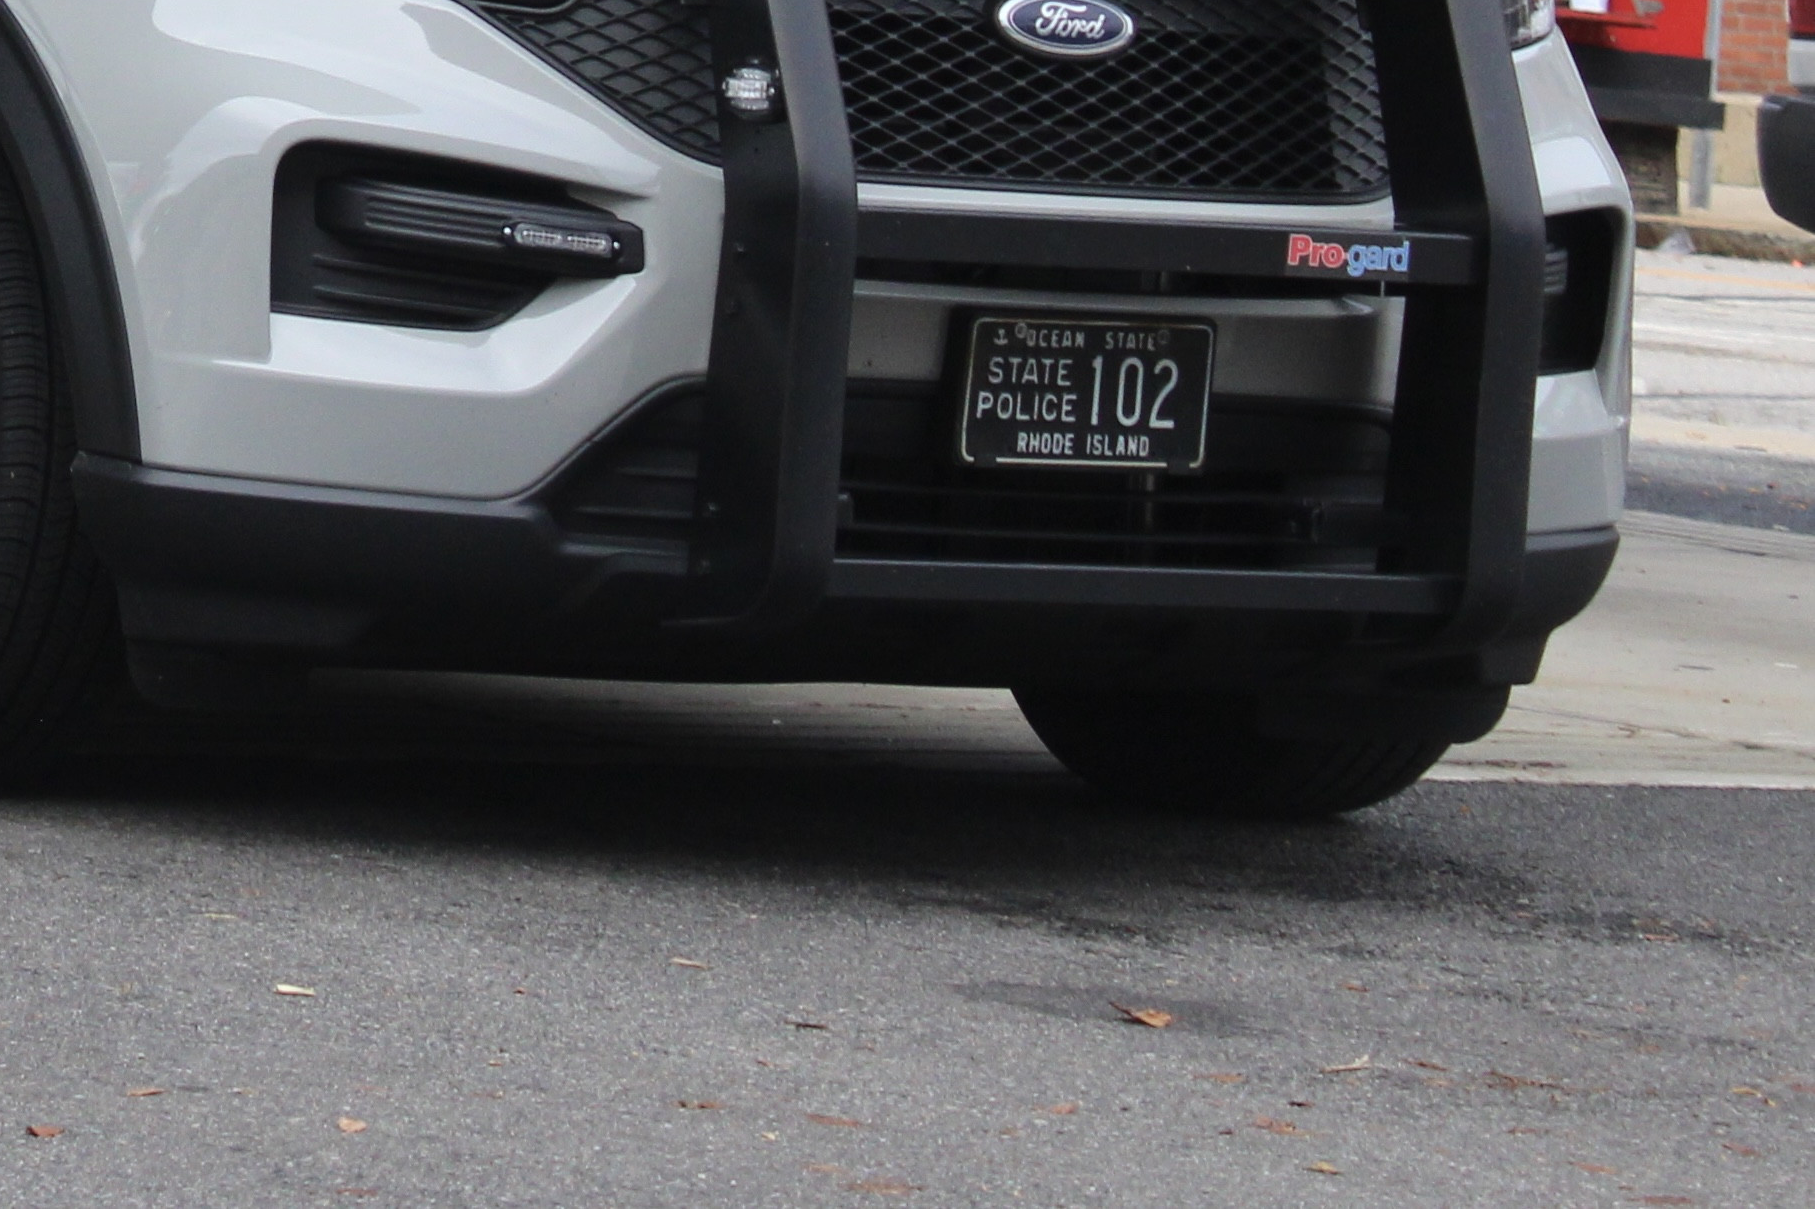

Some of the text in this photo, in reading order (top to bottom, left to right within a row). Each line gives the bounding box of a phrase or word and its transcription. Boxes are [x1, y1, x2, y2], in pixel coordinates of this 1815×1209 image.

[1035, 1, 1105, 39] Ford
[1026, 329, 1157, 351] OCEAN STATE
[988, 357, 1074, 386] STATE
[976, 391, 1078, 423] POLICE
[1091, 355, 1179, 429] 102
[1017, 432, 1150, 457] RHODE ISLAND
